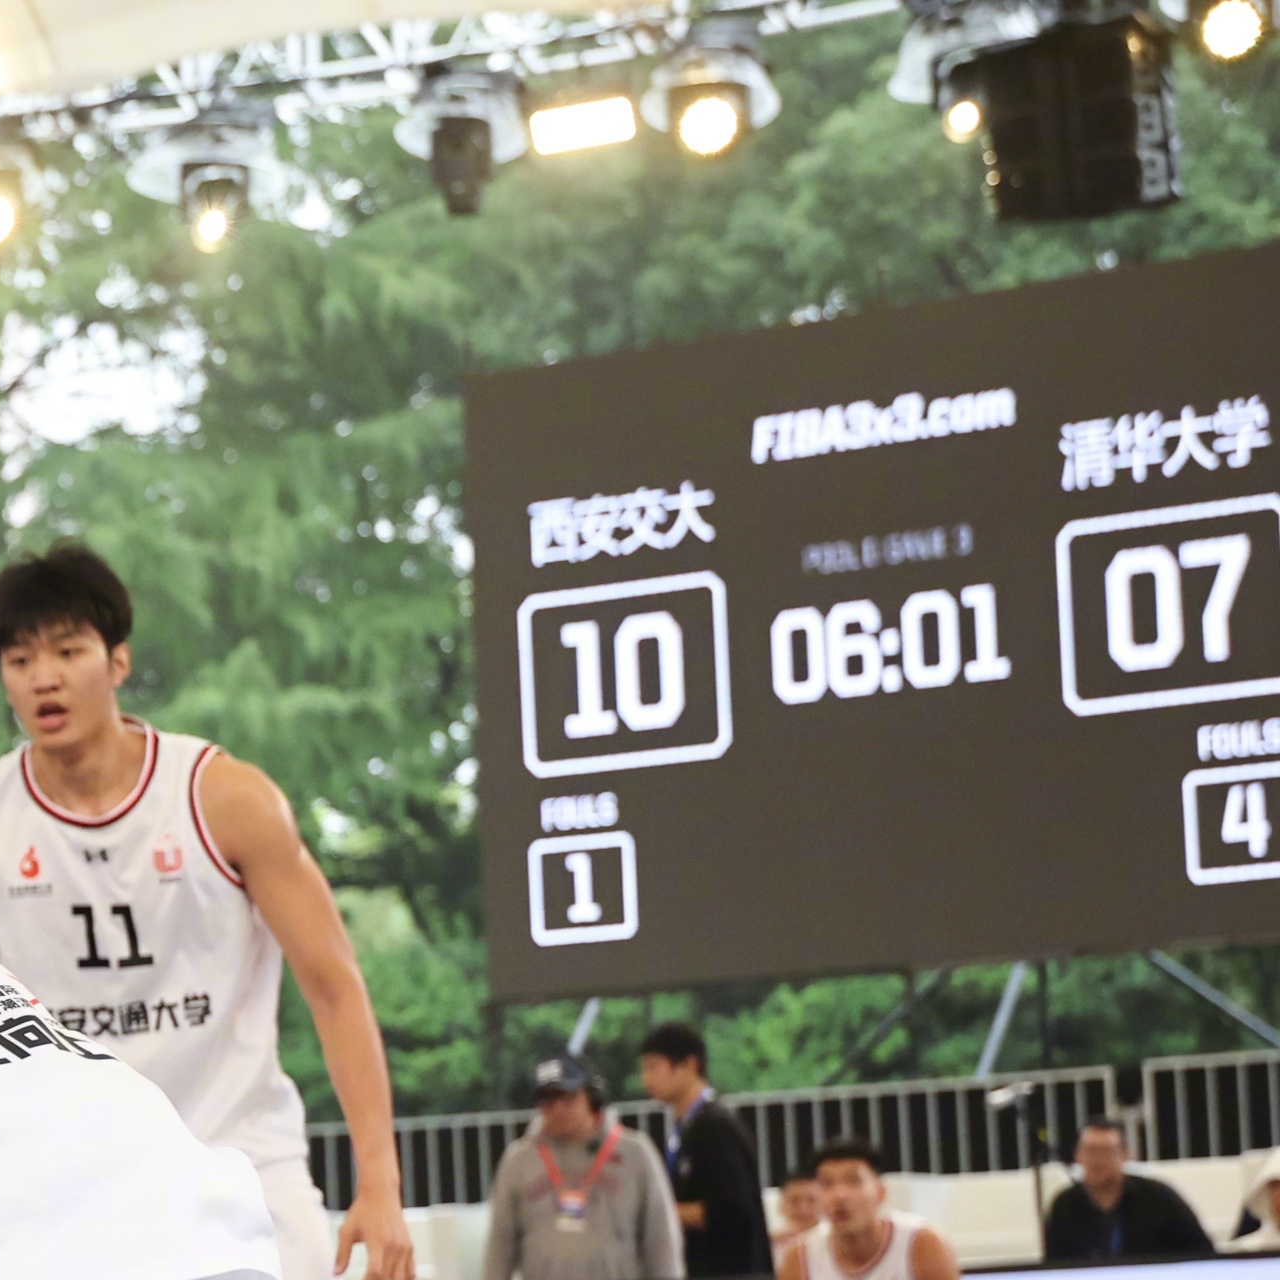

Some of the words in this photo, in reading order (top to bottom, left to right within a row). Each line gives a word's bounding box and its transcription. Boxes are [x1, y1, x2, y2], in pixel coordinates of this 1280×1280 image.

[1059, 395, 1272, 491] 清华大学
[527, 481, 716, 567] 西安交大
[770, 583, 1011, 704] 06:01
[1105, 533, 1251, 672] 07
[560, 611, 686, 739] 10
[1221, 781, 1272, 858] 4
[564, 852, 602, 923] 1
[72, 905, 154, 969] 11
[47, 993, 212, 1037] 安交通大学
